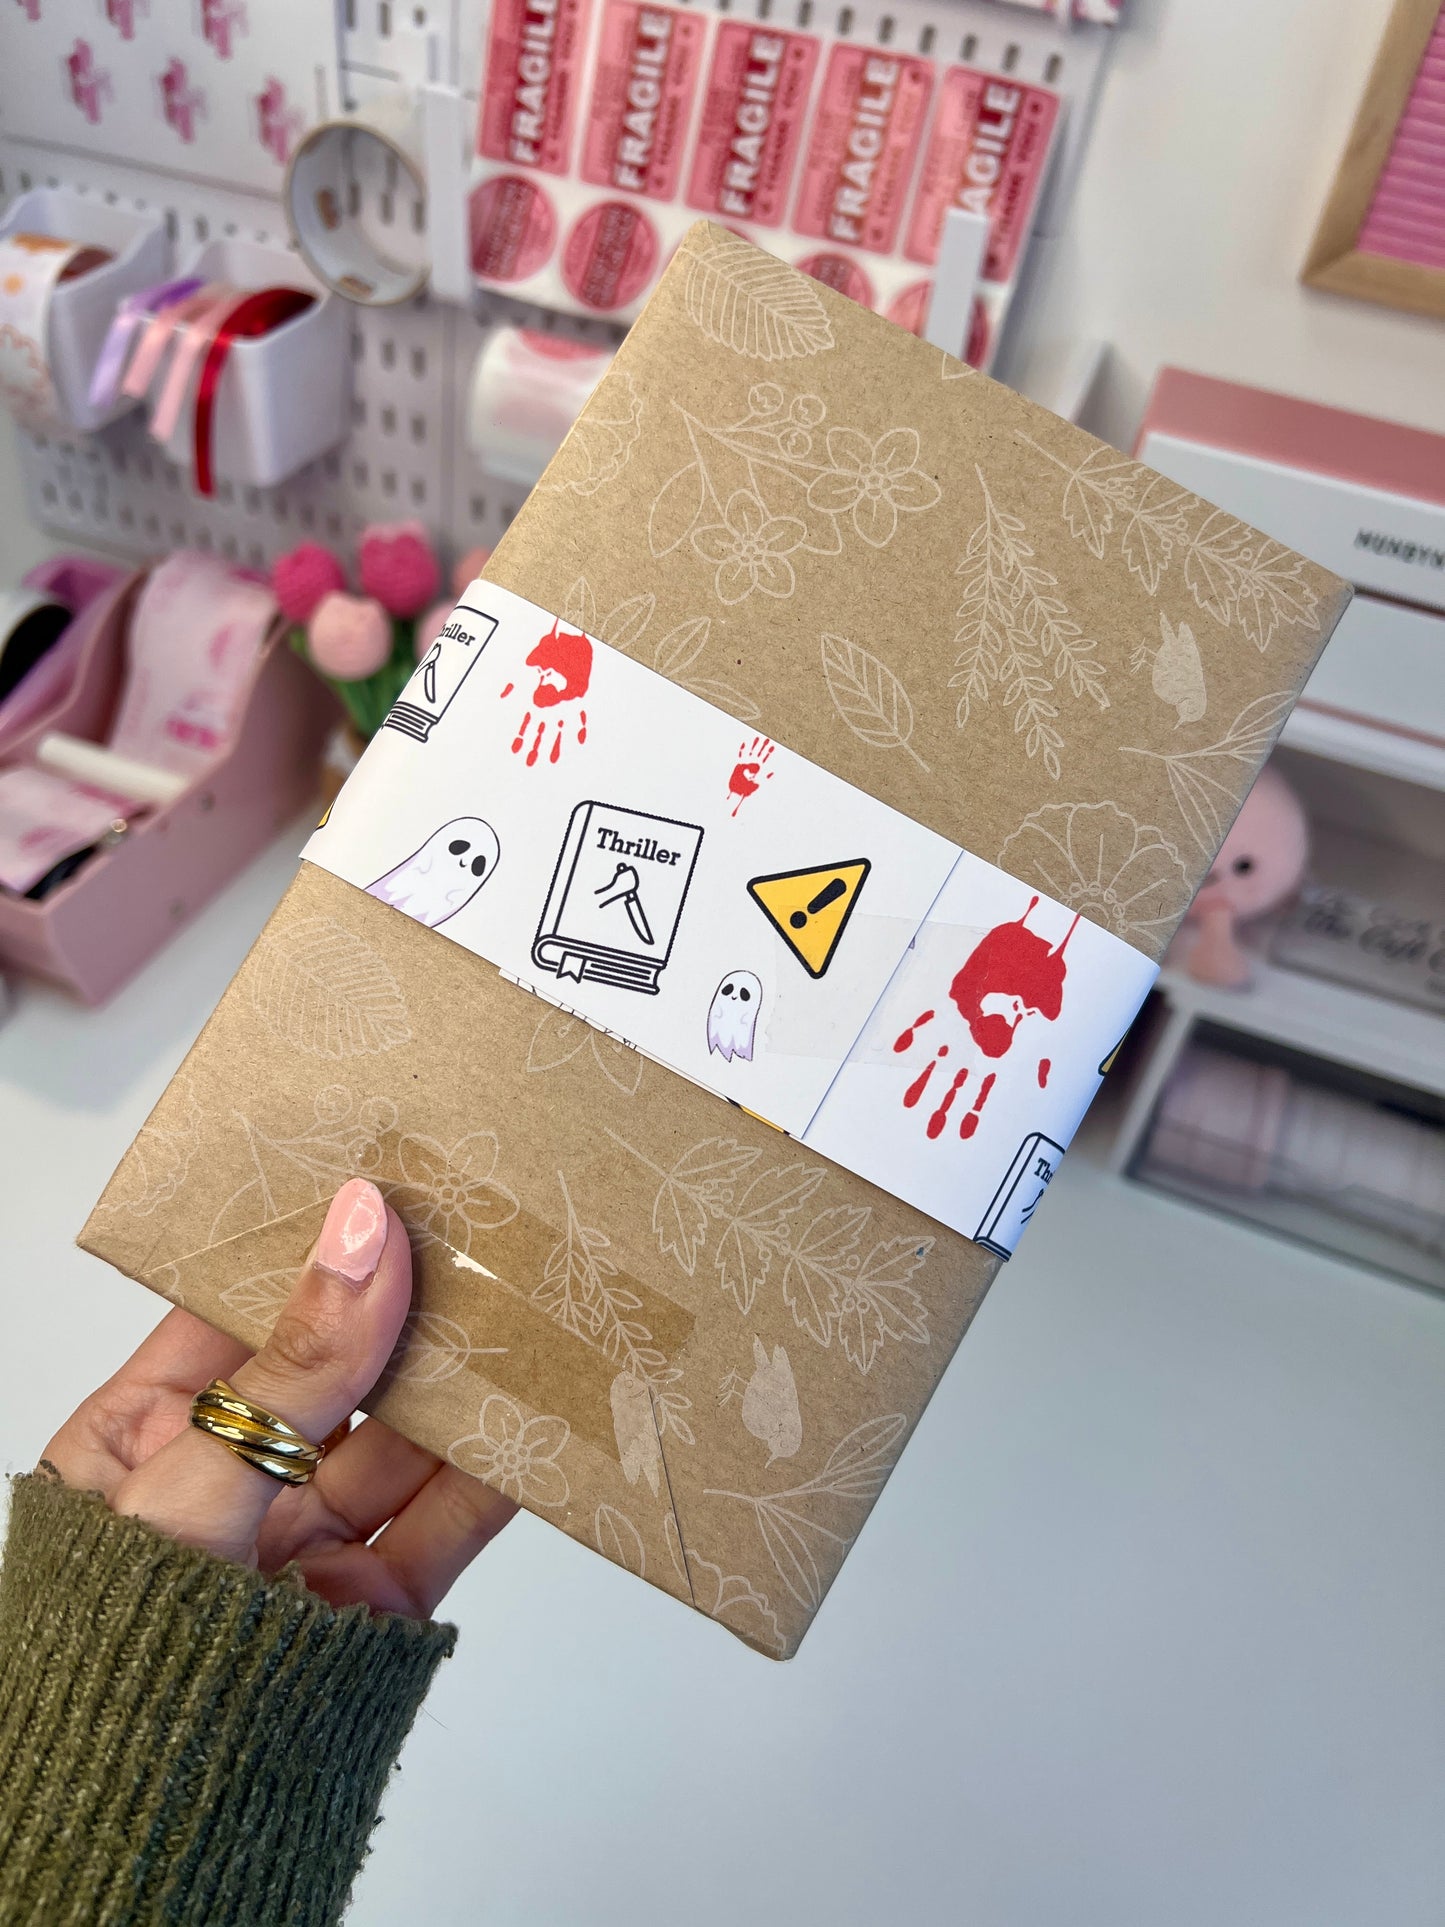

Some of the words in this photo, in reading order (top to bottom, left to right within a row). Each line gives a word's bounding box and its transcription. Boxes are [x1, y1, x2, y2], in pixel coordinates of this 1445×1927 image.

[615, 11, 673, 189] FRAGILE
[720, 35, 785, 214] FRAGILE
[830, 57, 900, 240] FRAGILE
[959, 83, 1021, 216] AGILE
[439, 623, 476, 646] hriller
[596, 827, 681, 866] Thriller
